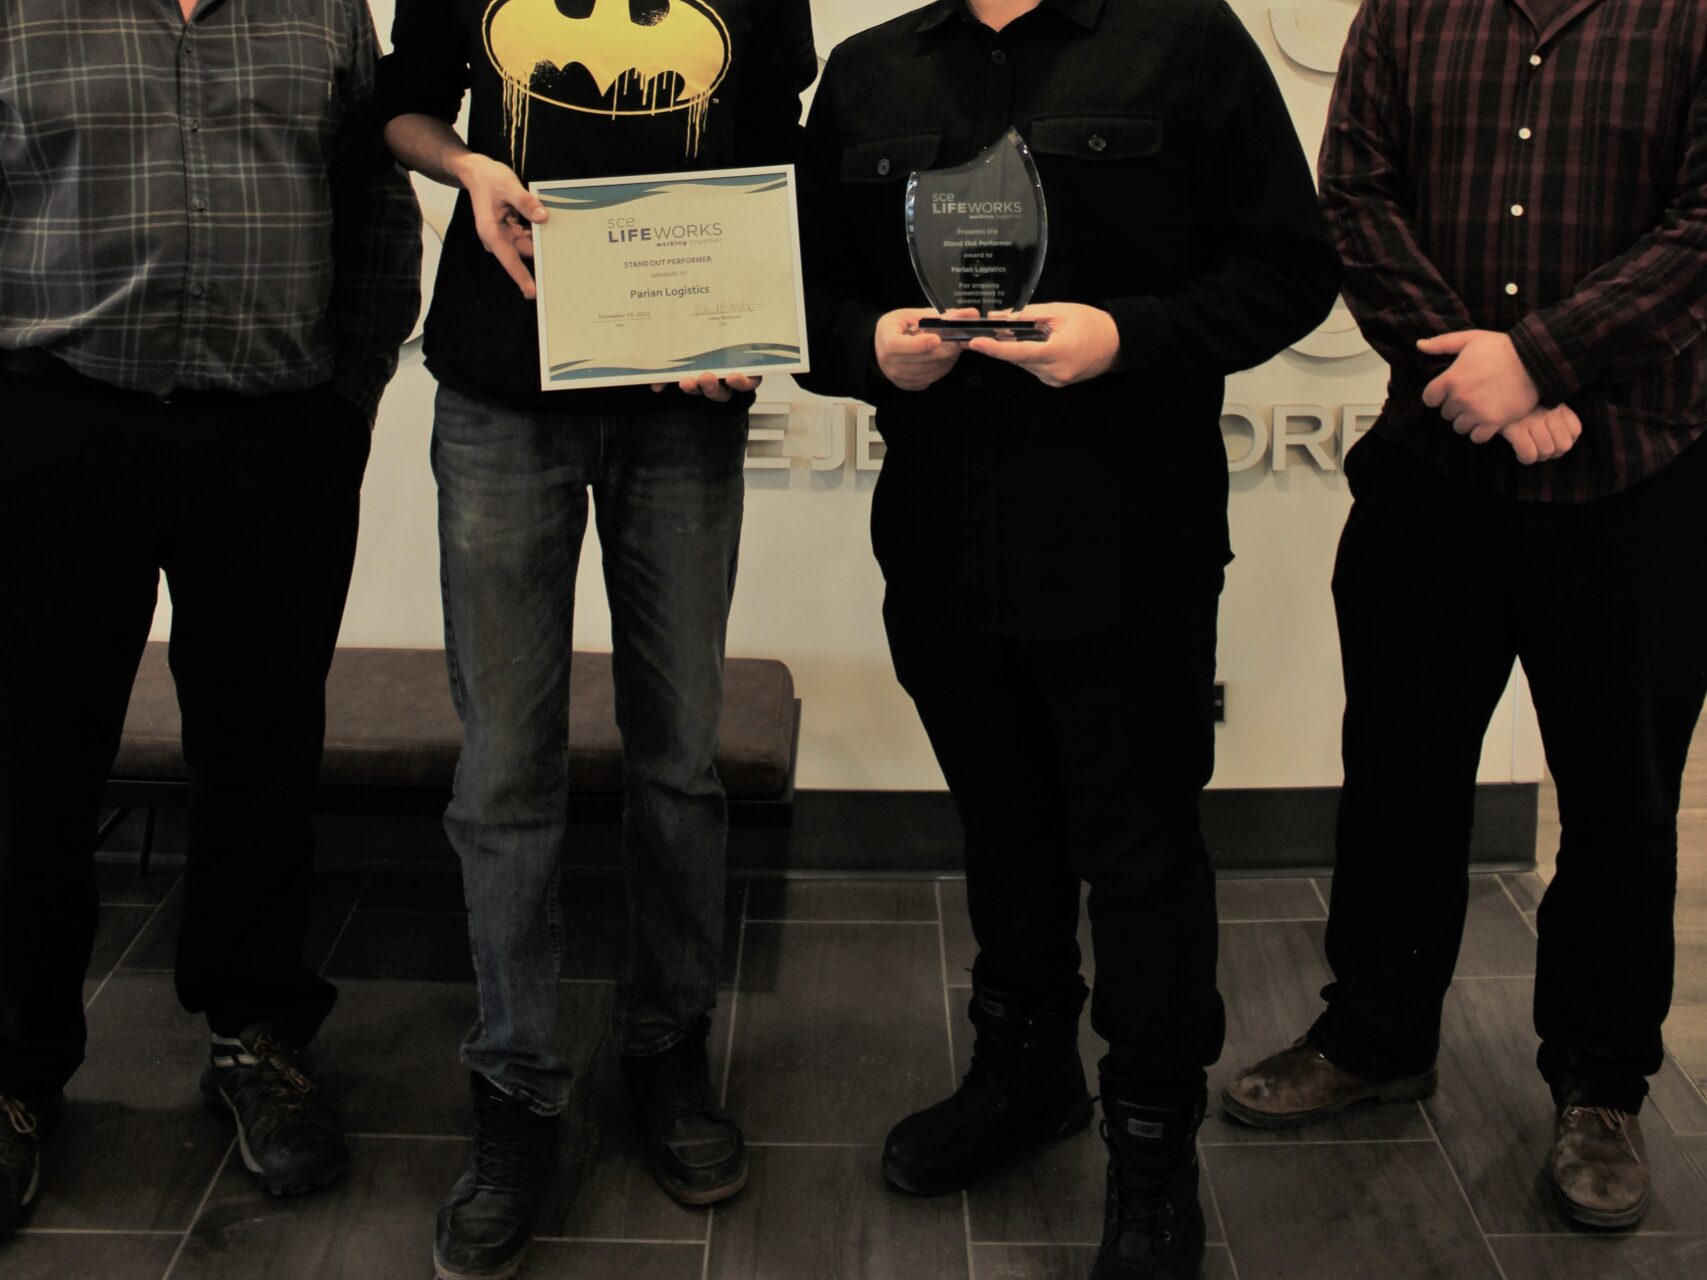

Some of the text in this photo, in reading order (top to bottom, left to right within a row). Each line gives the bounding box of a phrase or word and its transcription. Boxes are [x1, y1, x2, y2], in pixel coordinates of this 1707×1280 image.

[932, 192, 955, 202] sce
[932, 201, 1022, 214] LIFEWORKS
[608, 217, 635, 229] sce
[608, 222, 723, 243] LIFEWORKS
[656, 239, 687, 248] working
[624, 256, 712, 269] STAND OUT PERFORMER
[630, 284, 710, 299] Parian Logistics
